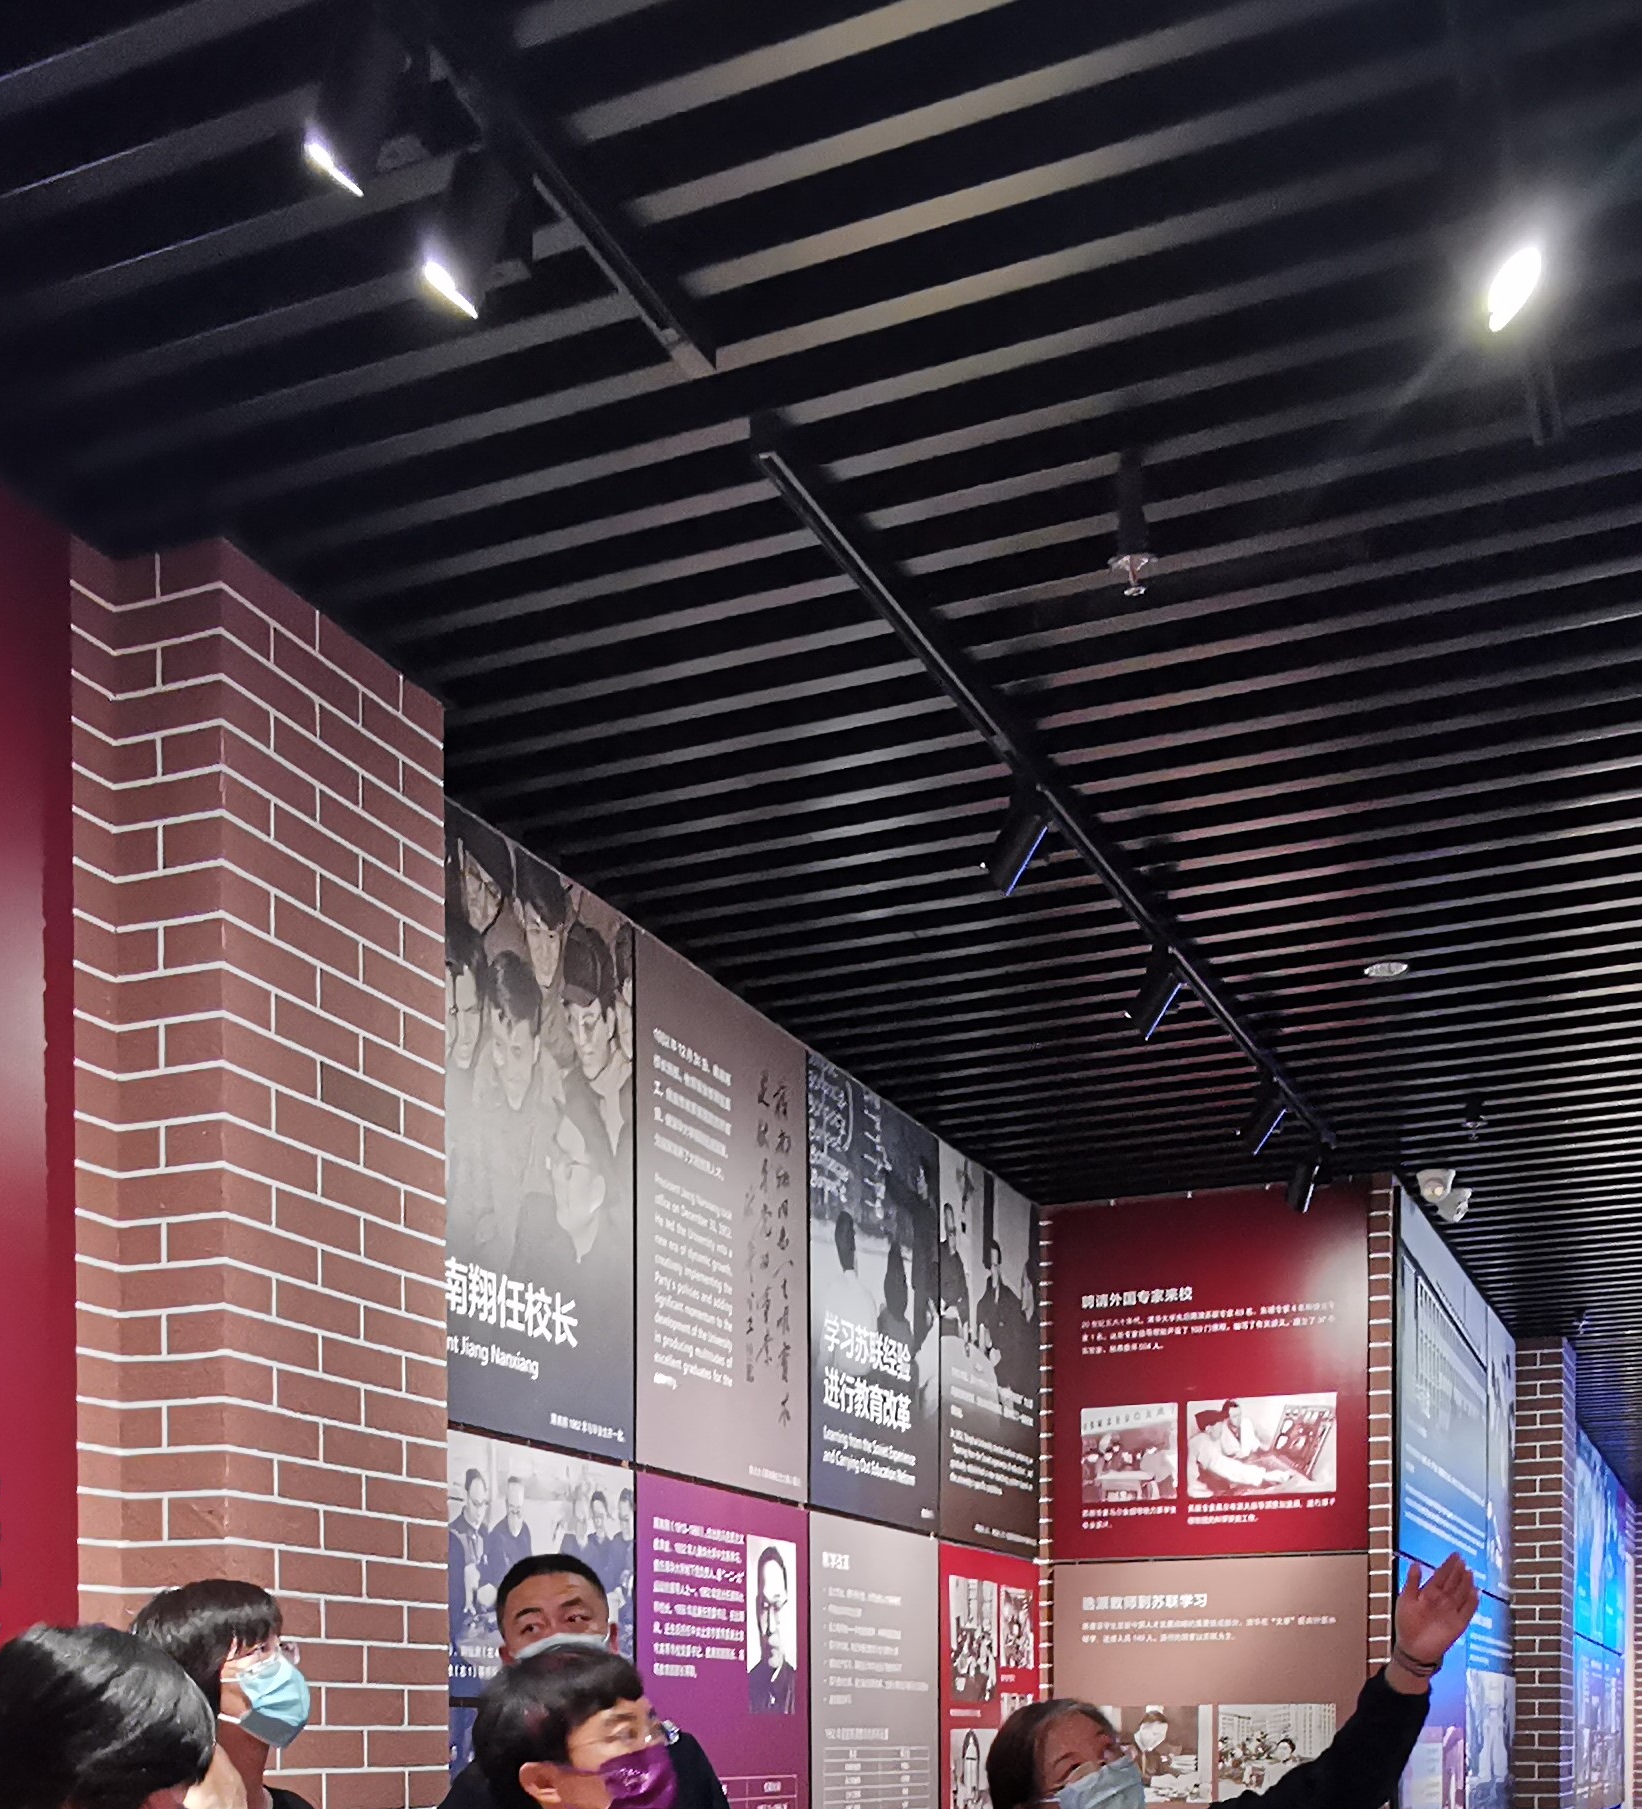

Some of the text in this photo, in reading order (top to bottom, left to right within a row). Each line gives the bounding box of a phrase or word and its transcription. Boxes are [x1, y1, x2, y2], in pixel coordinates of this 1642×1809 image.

[445, 1255, 579, 1348] 南翔任校长
[460, 1335, 489, 1366] Jiang
[490, 1344, 539, 1381] Nanxiang
[823, 1310, 912, 1382] 学习苏联经验
[823, 1366, 912, 1433] 进行教育改革
